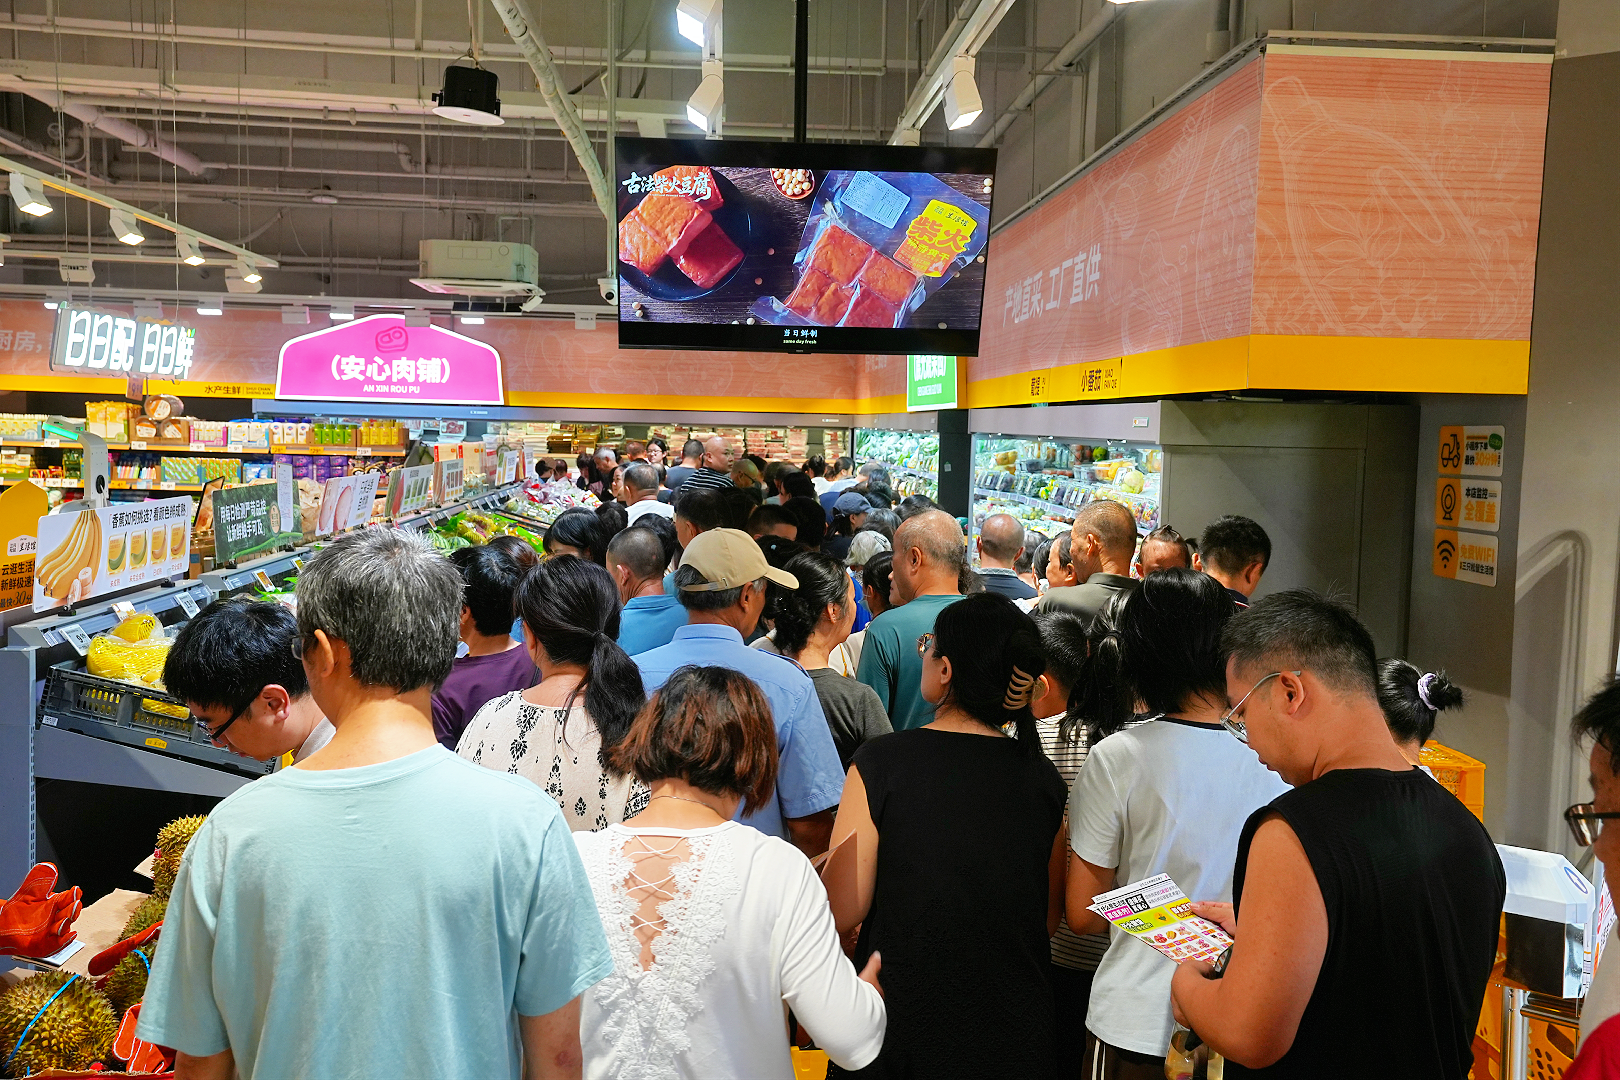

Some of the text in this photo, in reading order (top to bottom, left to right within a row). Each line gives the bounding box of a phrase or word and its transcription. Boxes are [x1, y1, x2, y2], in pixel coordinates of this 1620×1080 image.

[622, 171, 712, 202] 古法柴火豆腐
[907, 215, 970, 253] 柴火
[0, 330, 52, 353] 厨房，
[784, 328, 818, 338] 当日鲜制
[65, 310, 195, 379] 日日配 日日鲜
[204, 385, 241, 395] 水产生鲜
[363, 384, 420, 394] AN XIN ROU PU
[1081, 369, 1102, 392] 小番茄
[1465, 486, 1488, 499] 本店监控
[1464, 501, 1496, 524] 全覆盖
[2, 561, 35, 576] 云逛生活
[1, 576, 34, 591] 新鲜极速
